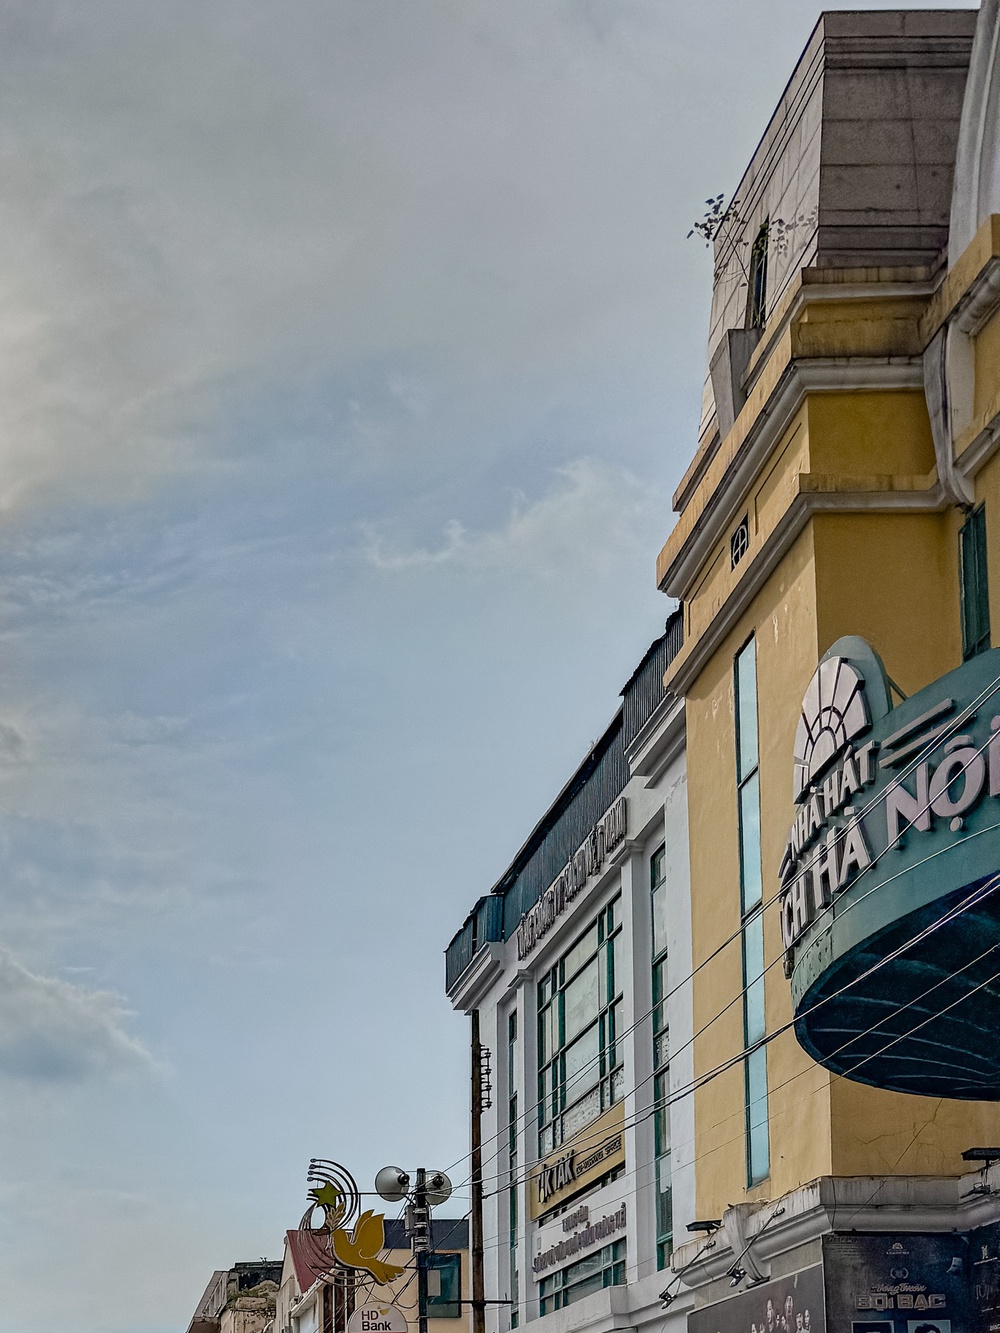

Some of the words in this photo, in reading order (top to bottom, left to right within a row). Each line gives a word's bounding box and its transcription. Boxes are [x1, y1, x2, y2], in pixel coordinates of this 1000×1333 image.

[791, 786, 824, 855] NHÀ
[823, 740, 878, 816] HÁT
[812, 805, 876, 909] HÀ
[361, 1311, 378, 1320] HD
[362, 1321, 392, 1331] Bank
